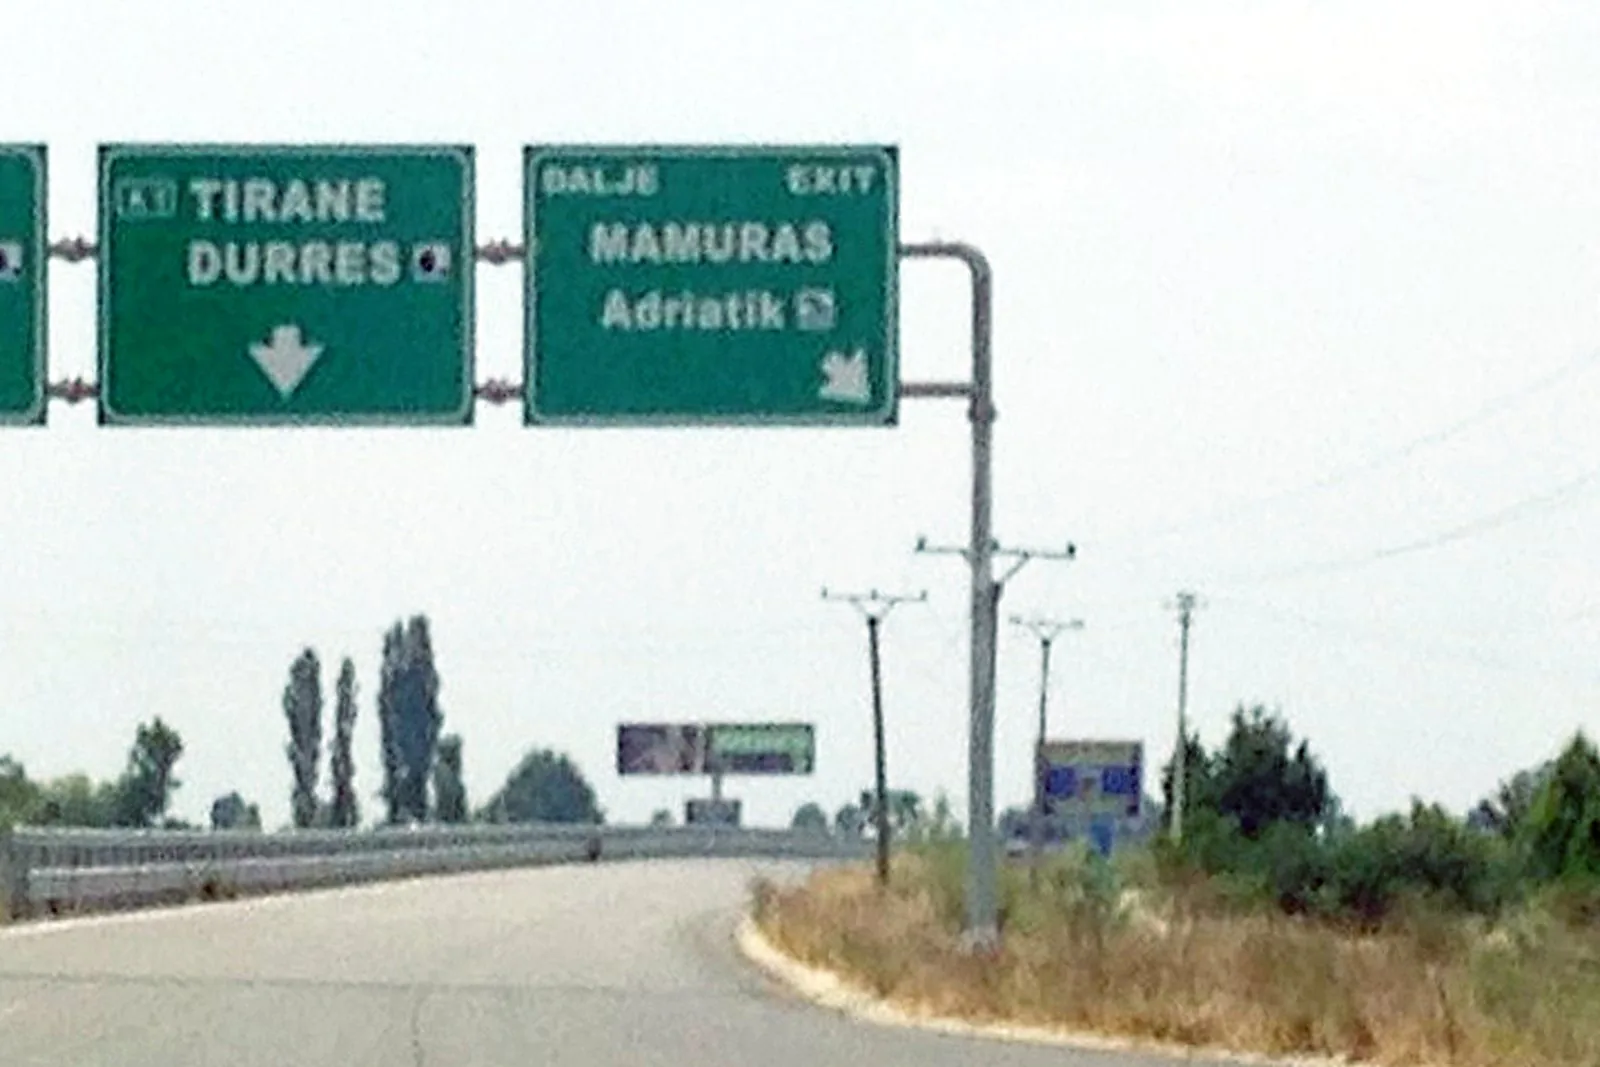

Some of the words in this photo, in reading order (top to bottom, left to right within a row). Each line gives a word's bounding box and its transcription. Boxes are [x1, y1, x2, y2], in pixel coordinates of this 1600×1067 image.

[190, 178, 386, 223] TIRANE
[786, 163, 877, 195] EXIT
[187, 240, 400, 285] DURRES
[590, 221, 834, 265] MAMURAS
[601, 288, 784, 330] Adriatik
